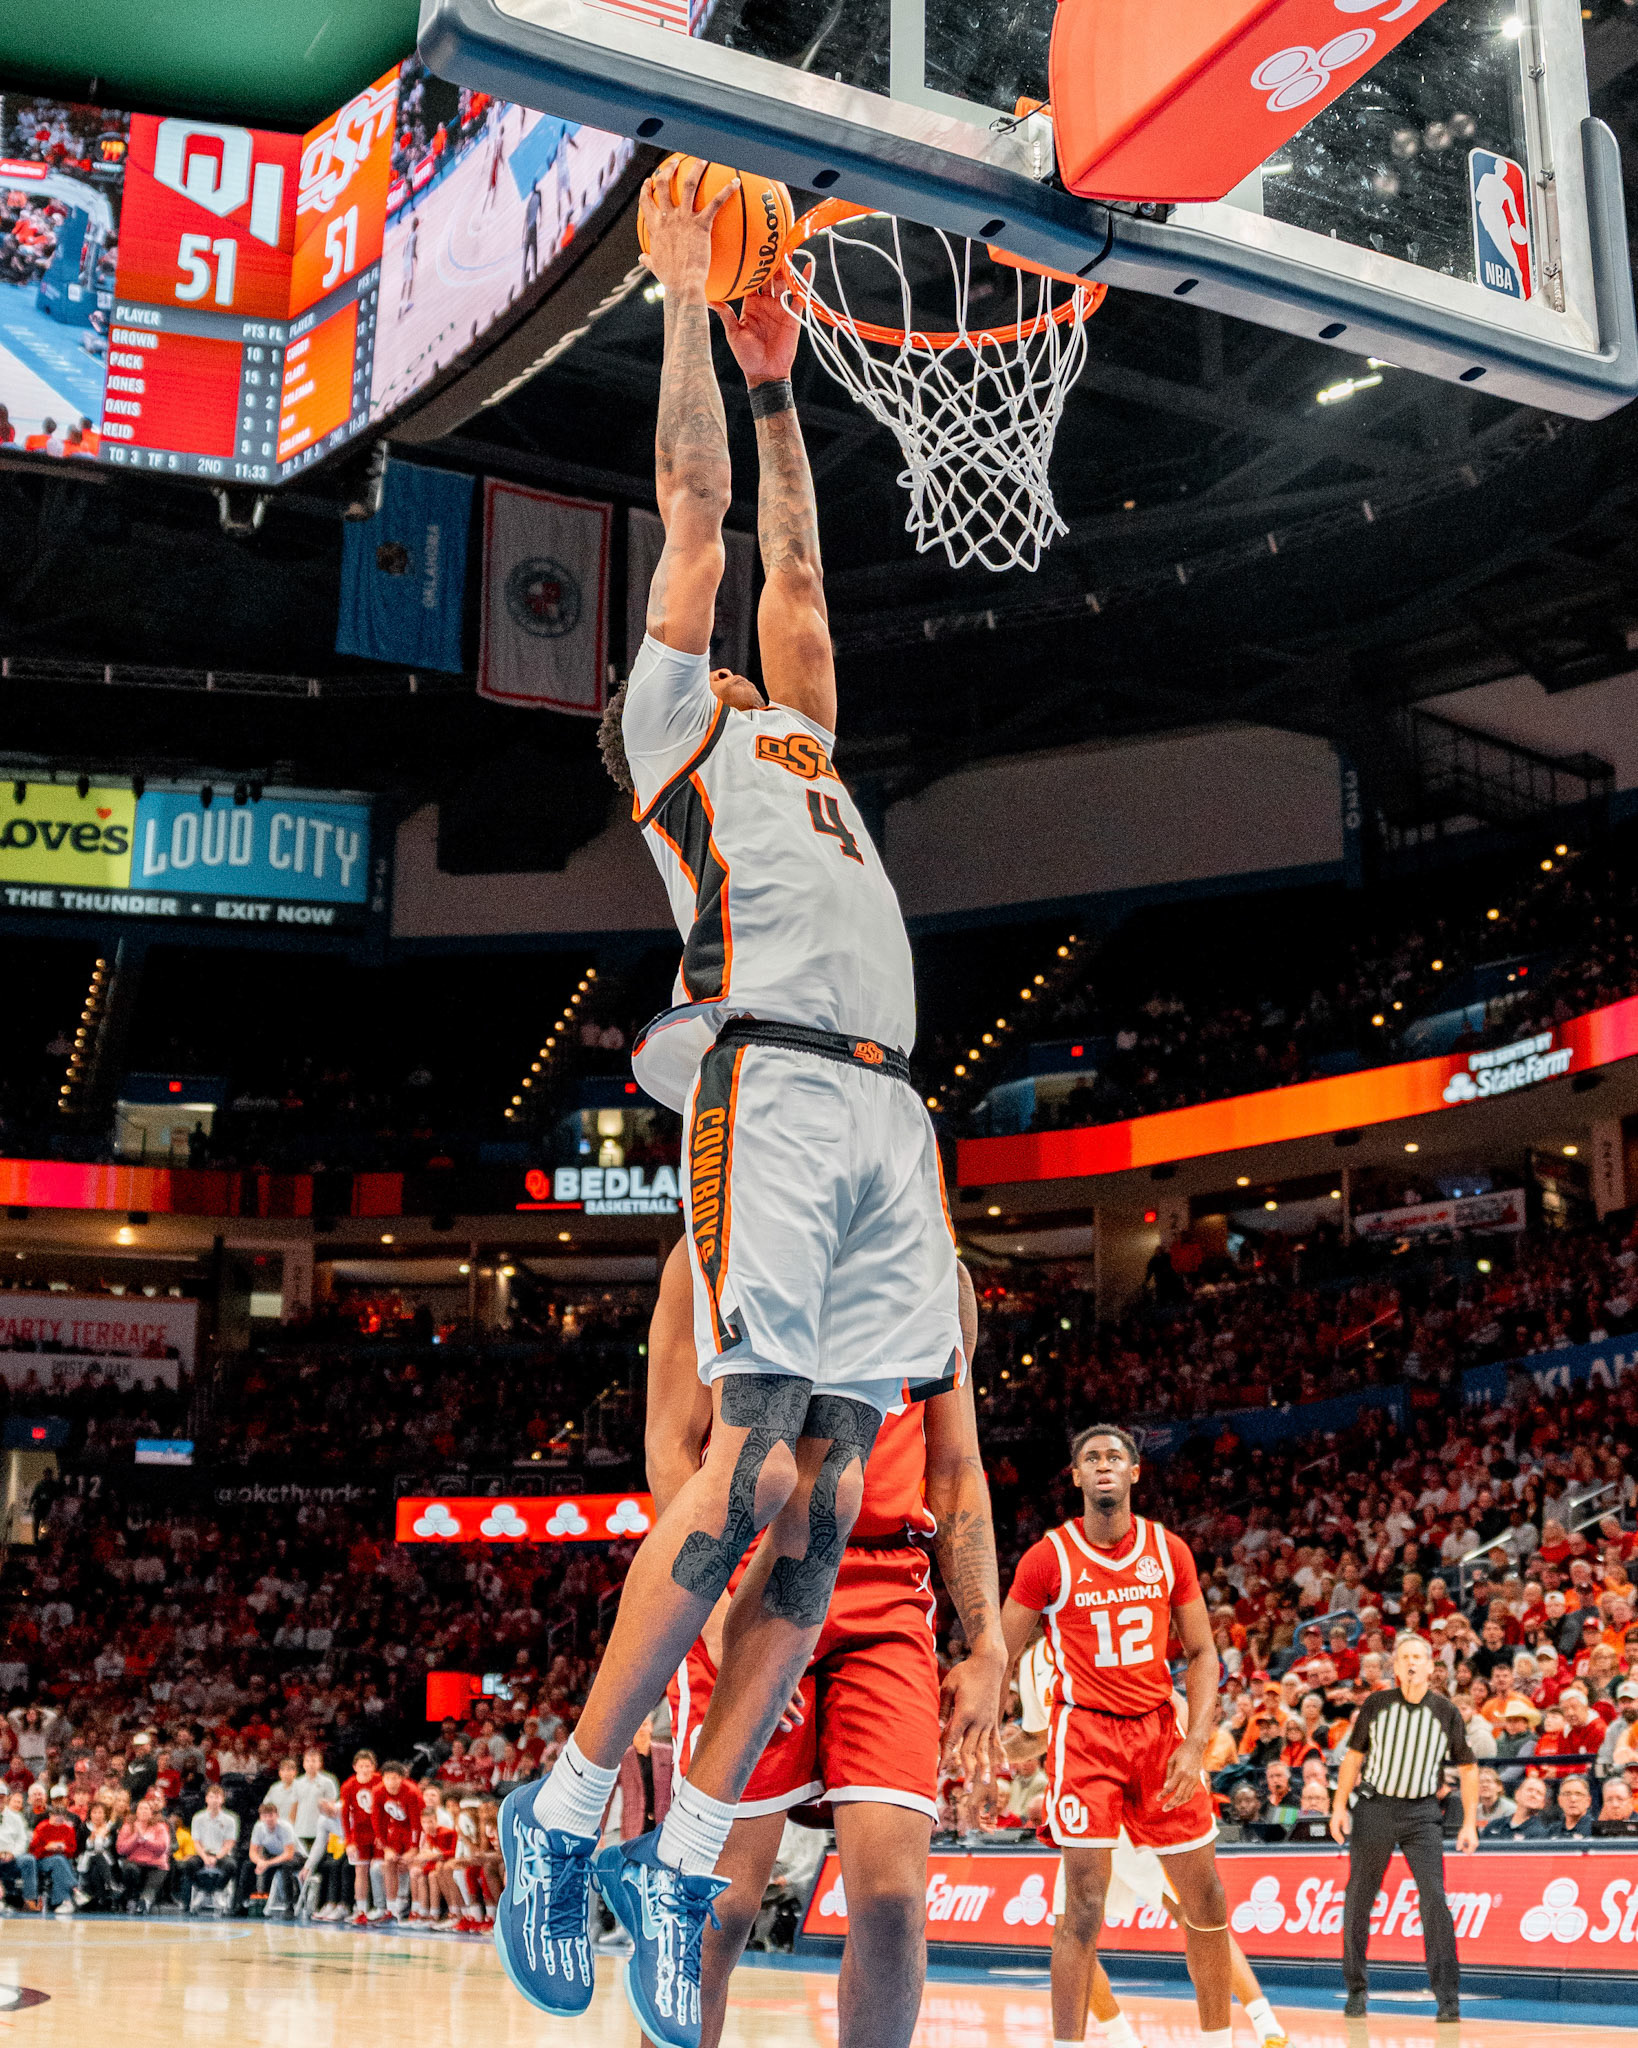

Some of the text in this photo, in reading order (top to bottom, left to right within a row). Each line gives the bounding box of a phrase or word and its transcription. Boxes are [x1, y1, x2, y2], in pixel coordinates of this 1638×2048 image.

[322, 204, 359, 289] 51
[742, 189, 779, 291] Wilson
[174, 233, 237, 306] 51
[1485, 260, 1513, 291] NBA
[116, 306, 284, 342] PLAYER PTS FL
[288, 312, 316, 339] PLAYER
[112, 328, 280, 365] BROWN 10 1
[109, 351, 144, 370] PACK
[269, 372, 279, 387] 1
[106, 374, 146, 394] JONES
[265, 395, 276, 410] 2
[104, 398, 274, 433] DAVIS 3 1
[102, 421, 135, 440] REID
[262, 442, 272, 457] 0
[109, 446, 126, 463] TO
[130, 449, 141, 464] 3
[147, 452, 164, 469] TF
[197, 457, 222, 474] 2ND
[234, 462, 270, 481] 11:33
[806, 789, 864, 865] 4
[143, 810, 360, 887] LOUD CITY
[4, 887, 336, 925] THE THUNDER EXIT NOW
[853, 1041, 884, 1065] OSU
[692, 1107, 727, 1264] COWBOYS
[585, 1199, 679, 1215] BASKETBALL
[71, 1320, 168, 1348] TERRACE
[1075, 1584, 1163, 1607] OKLAHOMA
[1090, 1605, 1155, 1668] 12
[1059, 1795, 1089, 1834] OU
